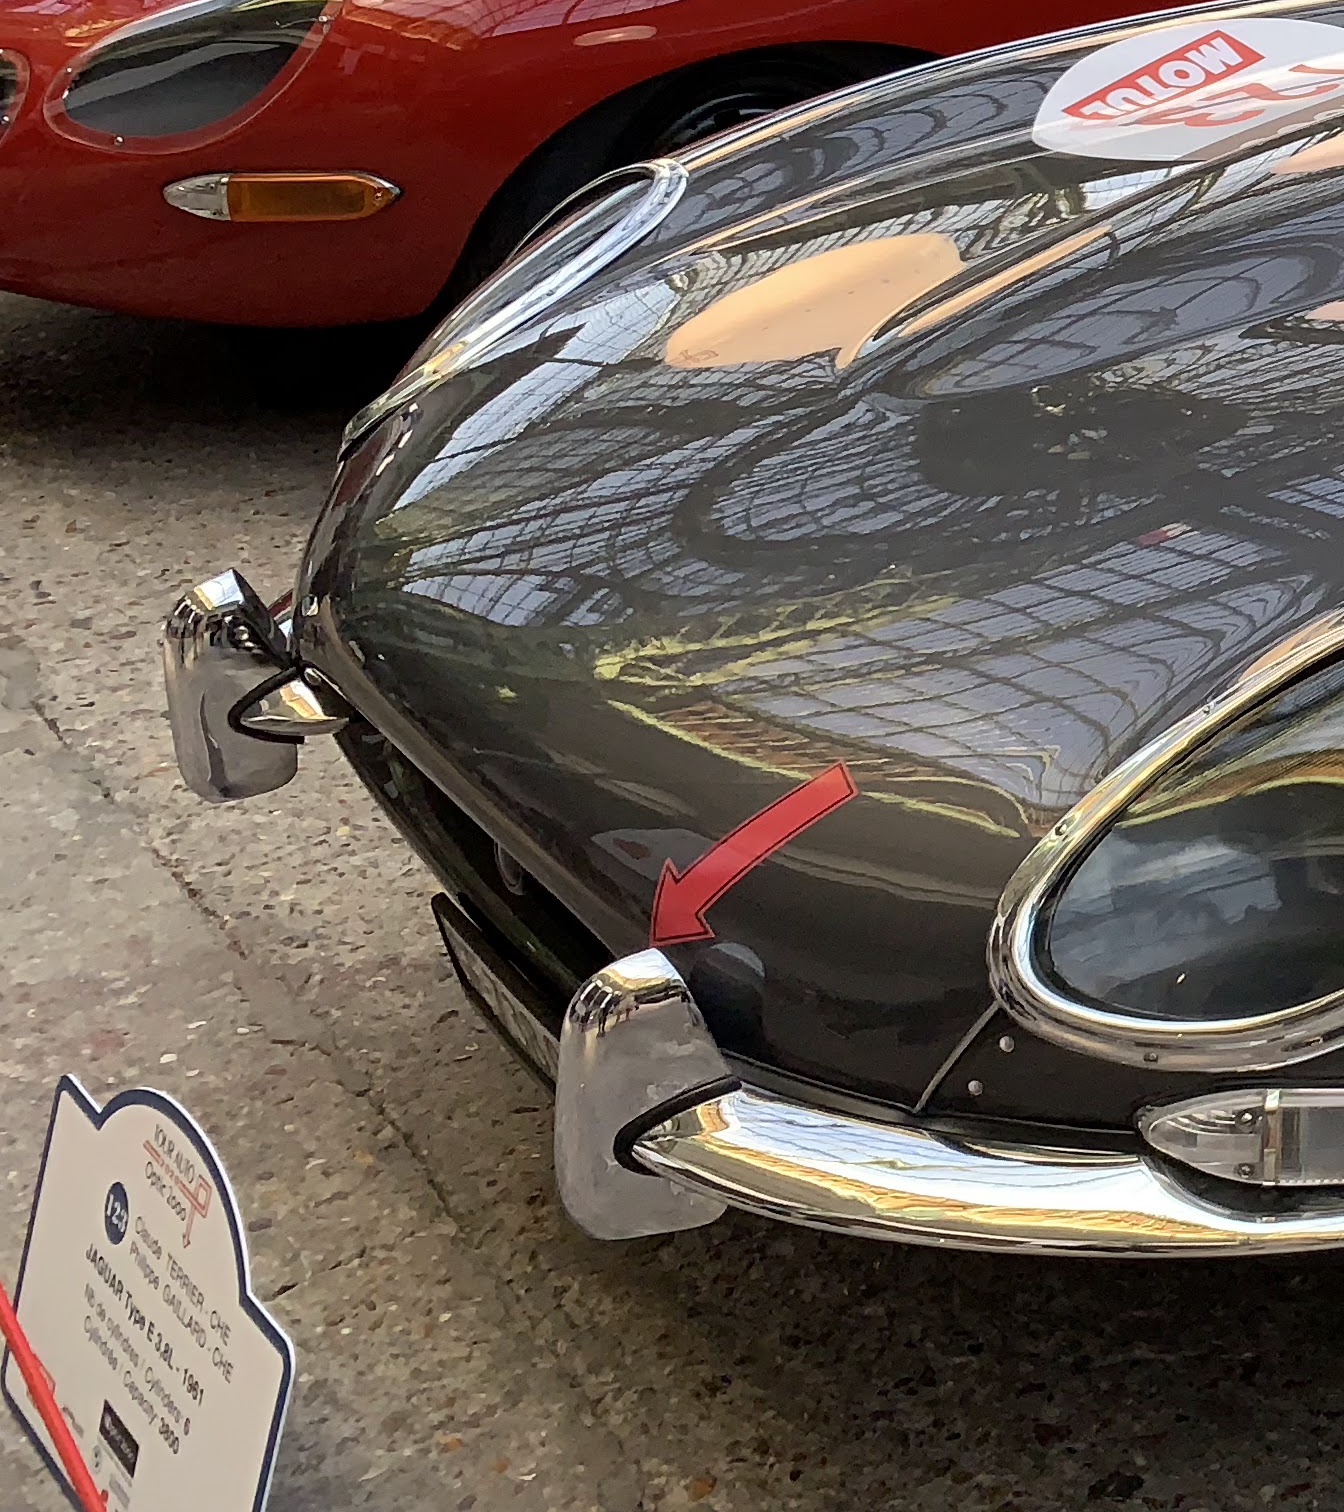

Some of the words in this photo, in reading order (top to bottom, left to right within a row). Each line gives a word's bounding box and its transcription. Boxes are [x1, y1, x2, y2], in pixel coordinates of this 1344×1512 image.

[1080, 35, 1245, 119] MOTUL
[145, 1161, 166, 1198] Optic
[166, 1186, 187, 1222] 2000
[154, 1123, 175, 1160] TOUR
[173, 1150, 195, 1184] AUTO
[106, 1193, 128, 1233] 123
[85, 1243, 124, 1302] JAGUAR
[124, 1290, 146, 1331] Type
[146, 1320, 155, 1343] E
[181, 1367, 204, 1407] 1961
[162, 1284, 207, 1349] GAILLARD
[211, 1346, 234, 1384] CHE
[166, 1252, 205, 1313] TERRIER
[209, 1310, 232, 1347] CHE
